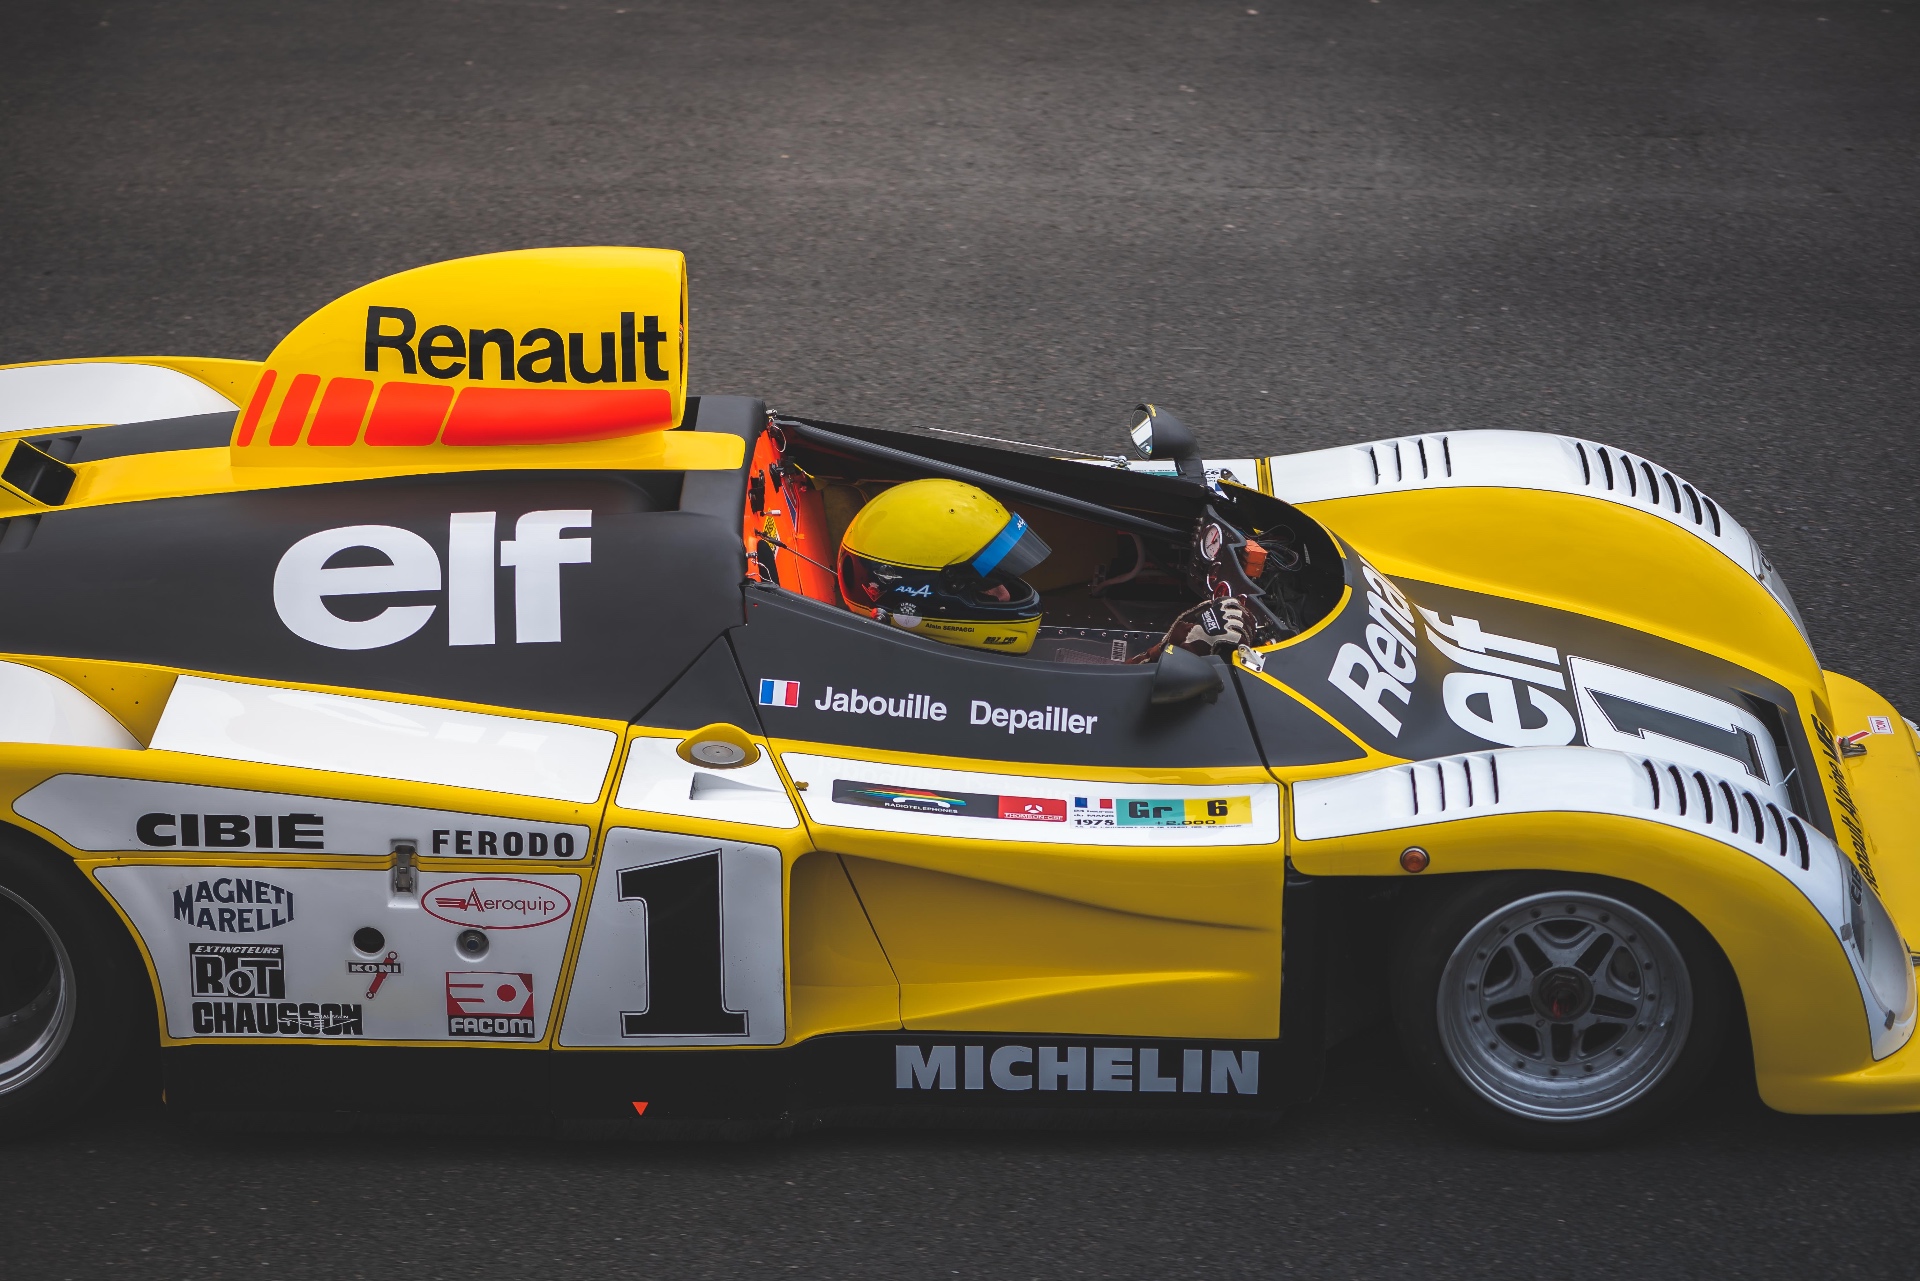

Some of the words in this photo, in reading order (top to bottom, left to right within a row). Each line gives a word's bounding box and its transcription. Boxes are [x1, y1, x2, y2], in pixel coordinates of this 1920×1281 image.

[365, 305, 670, 384] Renault
[272, 509, 593, 651] elf
[1327, 554, 1418, 739] Rena
[1412, 602, 1577, 747] elf
[815, 687, 947, 721] Jabouille
[970, 700, 1098, 734] Depailler
[884, 802, 959, 814] RADIOTELEPHONES
[1128, 801, 1173, 819] Gr
[1207, 800, 1228, 817] 6
[432, 829, 575, 858] FERODO
[464, 887, 556, 915] Aeroquip
[194, 945, 281, 954] EXTINCTEURS
[617, 848, 749, 1037] 1
[350, 963, 400, 974] KONI
[192, 1001, 363, 1035] CHAUSSON
[450, 1017, 533, 1034] FACOM
[895, 1045, 1260, 1095] MICHELIN
